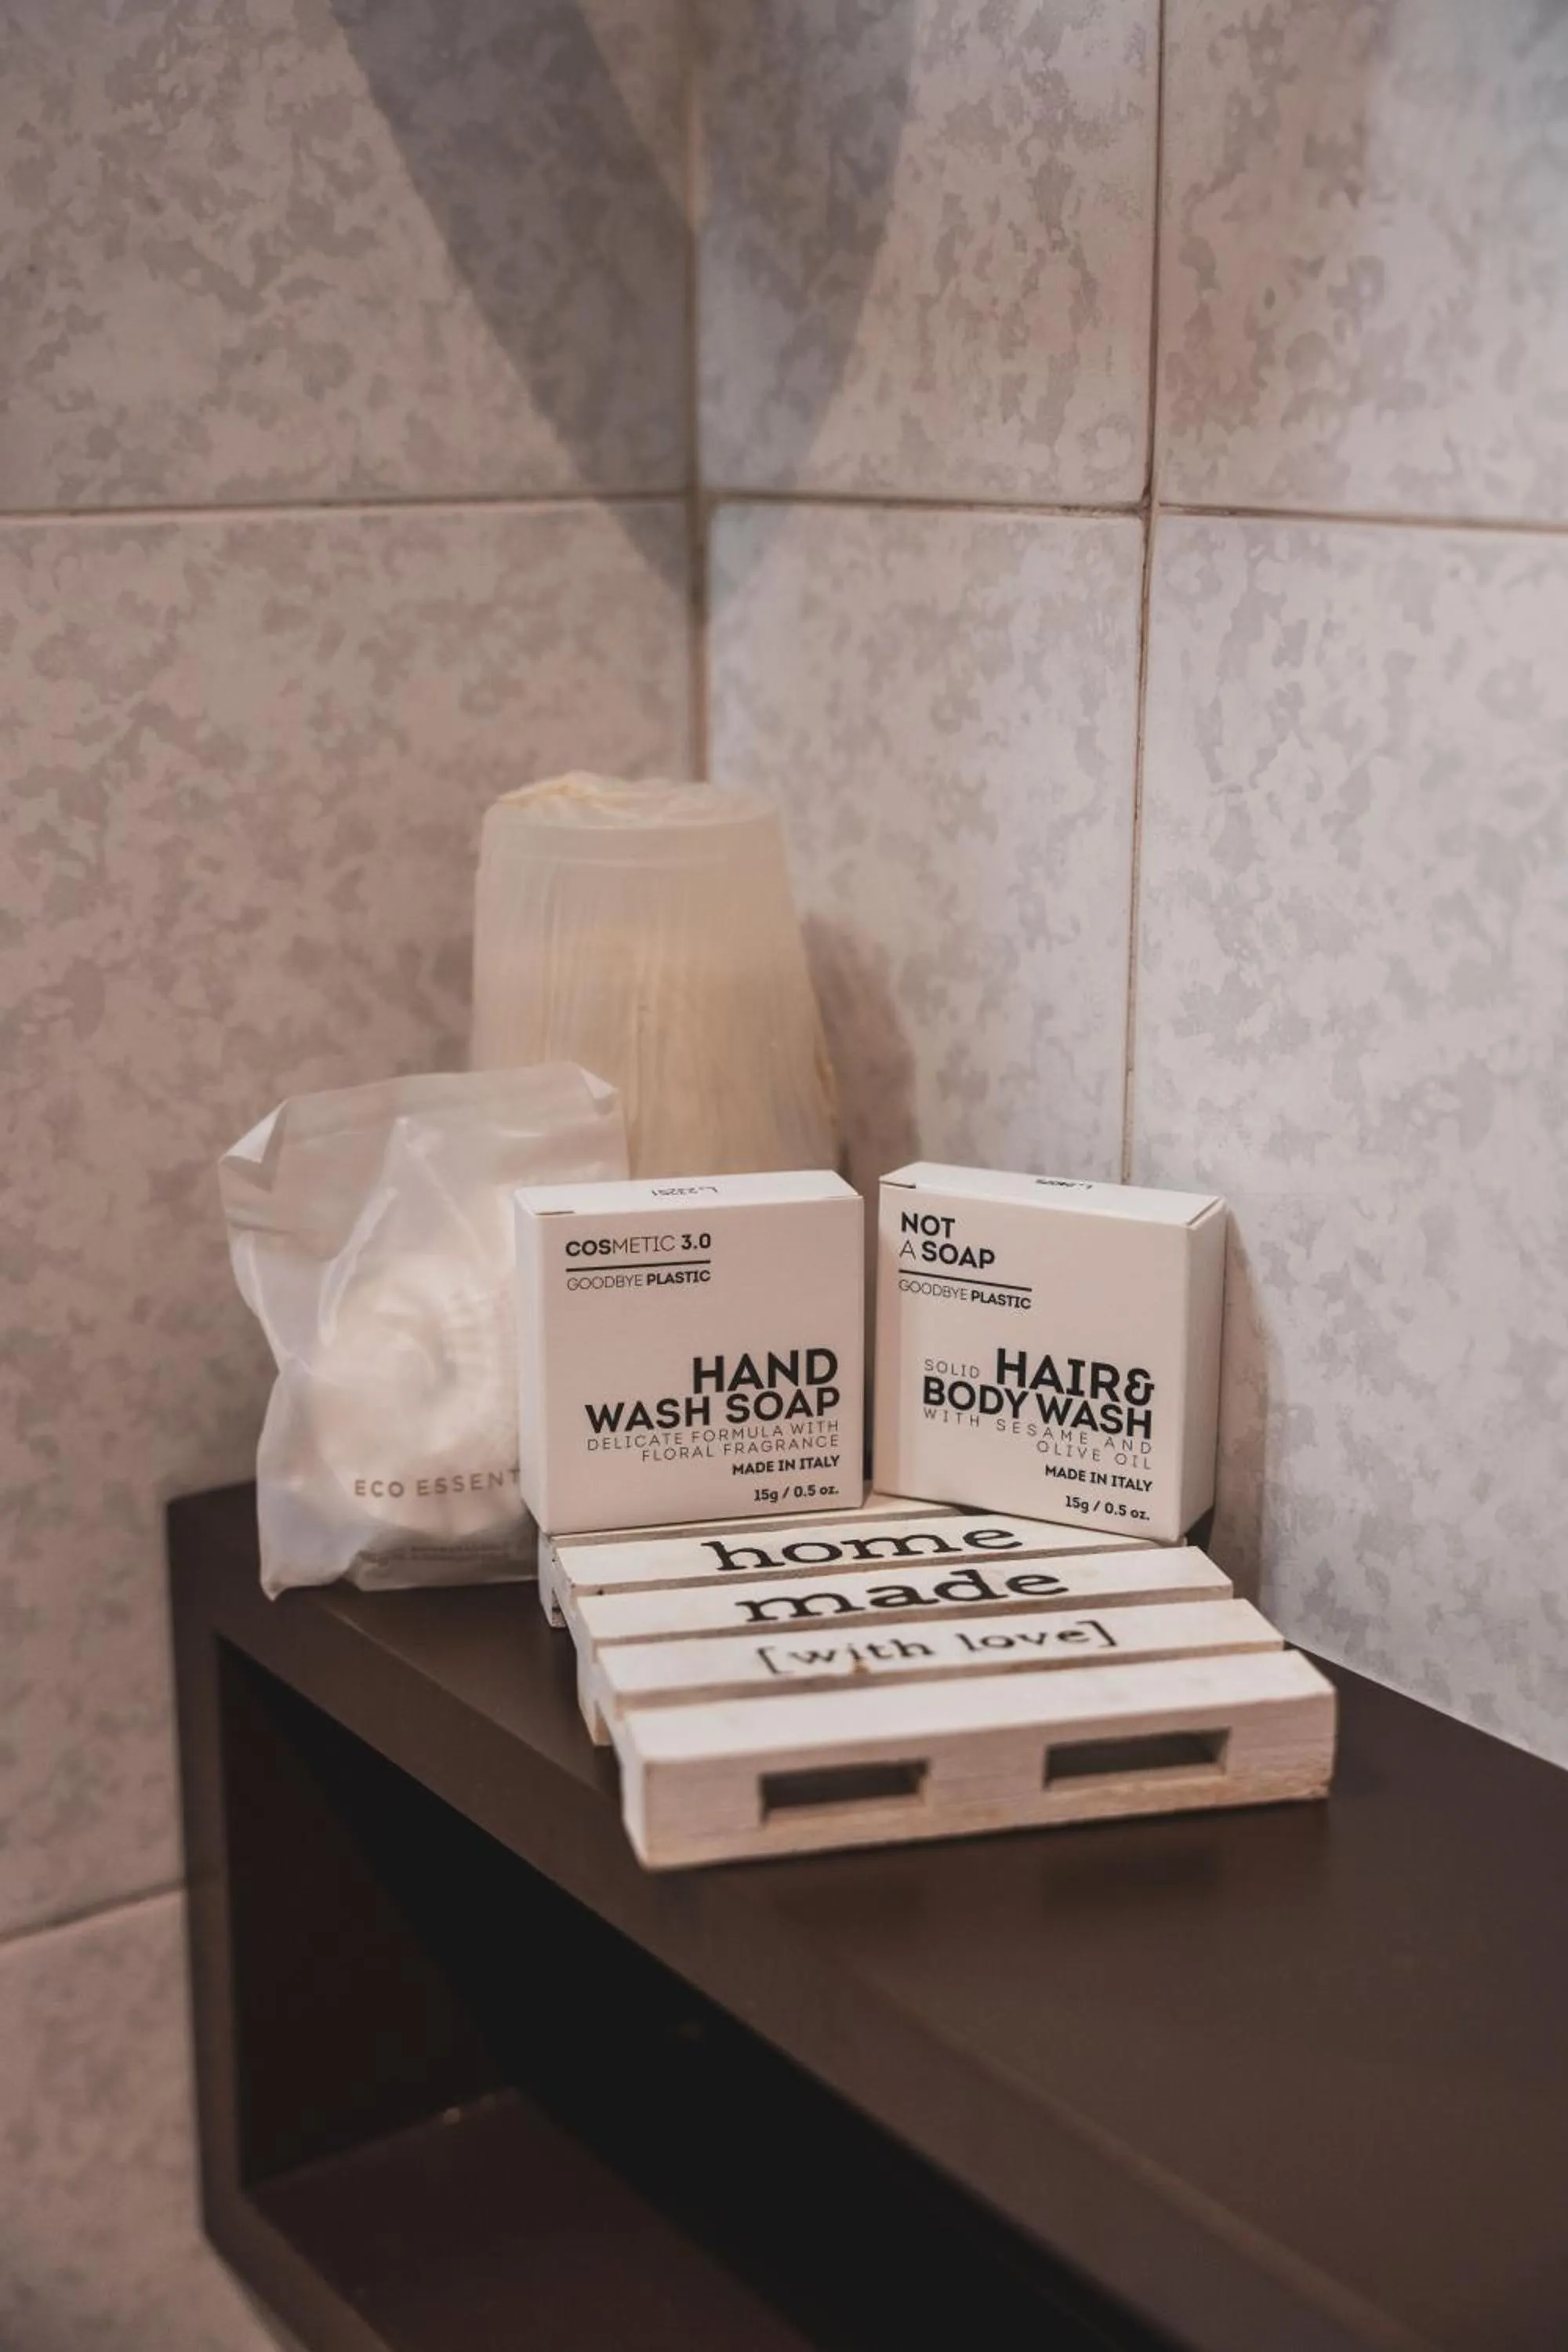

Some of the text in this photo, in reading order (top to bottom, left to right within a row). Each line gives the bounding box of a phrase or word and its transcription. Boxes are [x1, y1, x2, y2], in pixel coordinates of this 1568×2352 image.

[901, 1211, 955, 1239] NOT
[565, 1233, 711, 1257] COSMETIC 3.0
[899, 1240, 995, 1269] A SOAP
[567, 1270, 711, 1290] GOODBYE PLASTIC
[898, 1279, 1032, 1309] GOODBYE PLASTIC
[693, 1348, 838, 1394] HAND
[924, 1348, 1155, 1406] SOLID HAIR&
[585, 1387, 840, 1434] WASH SOAP
[924, 1376, 1152, 1439] BODY WASH
[587, 1420, 839, 1451] DELICATE FORMULA WITH
[924, 1407, 1152, 1454] WITH SESAME AND
[642, 1435, 839, 1462] FLORAL FRAGRANCE
[1036, 1440, 1151, 1470] OLIVE OIL
[732, 1455, 840, 1475] MADE IN ITALY
[1045, 1465, 1152, 1492] MADE IN ITALY
[354, 1479, 405, 1497] ECO
[754, 1485, 839, 1503] 15g / 0.5 oz.
[1065, 1495, 1150, 1520] 15g / 0.5 oz.
[701, 1527, 1022, 1571] home
[735, 1568, 1069, 1623] made
[757, 1620, 1120, 1675] [with love]
